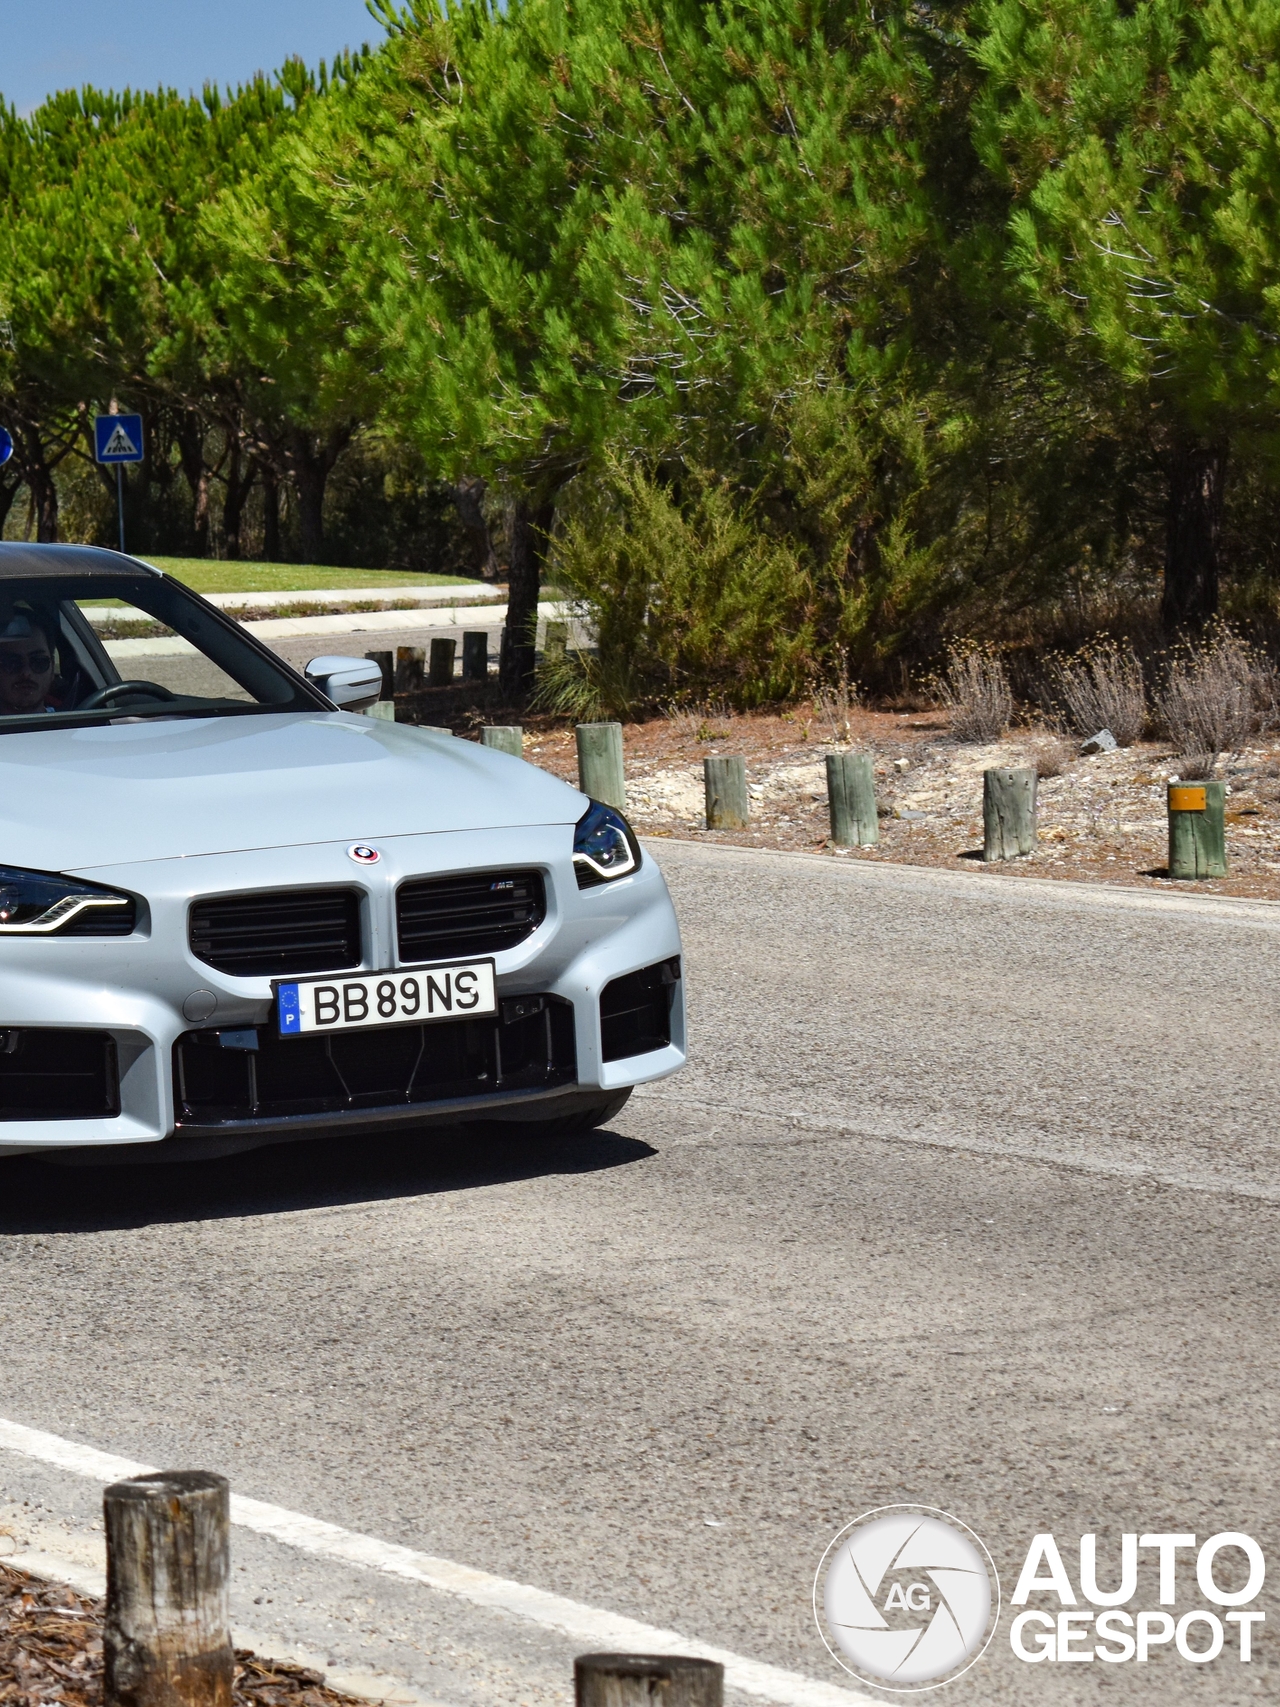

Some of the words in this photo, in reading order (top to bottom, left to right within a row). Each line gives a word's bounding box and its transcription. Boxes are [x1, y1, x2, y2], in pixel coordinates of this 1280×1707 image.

[492, 881, 514, 889] M2
[314, 983, 369, 1025] BB
[376, 978, 420, 1018] 89
[426, 971, 479, 1013] NS
[286, 1014, 295, 1025] P
